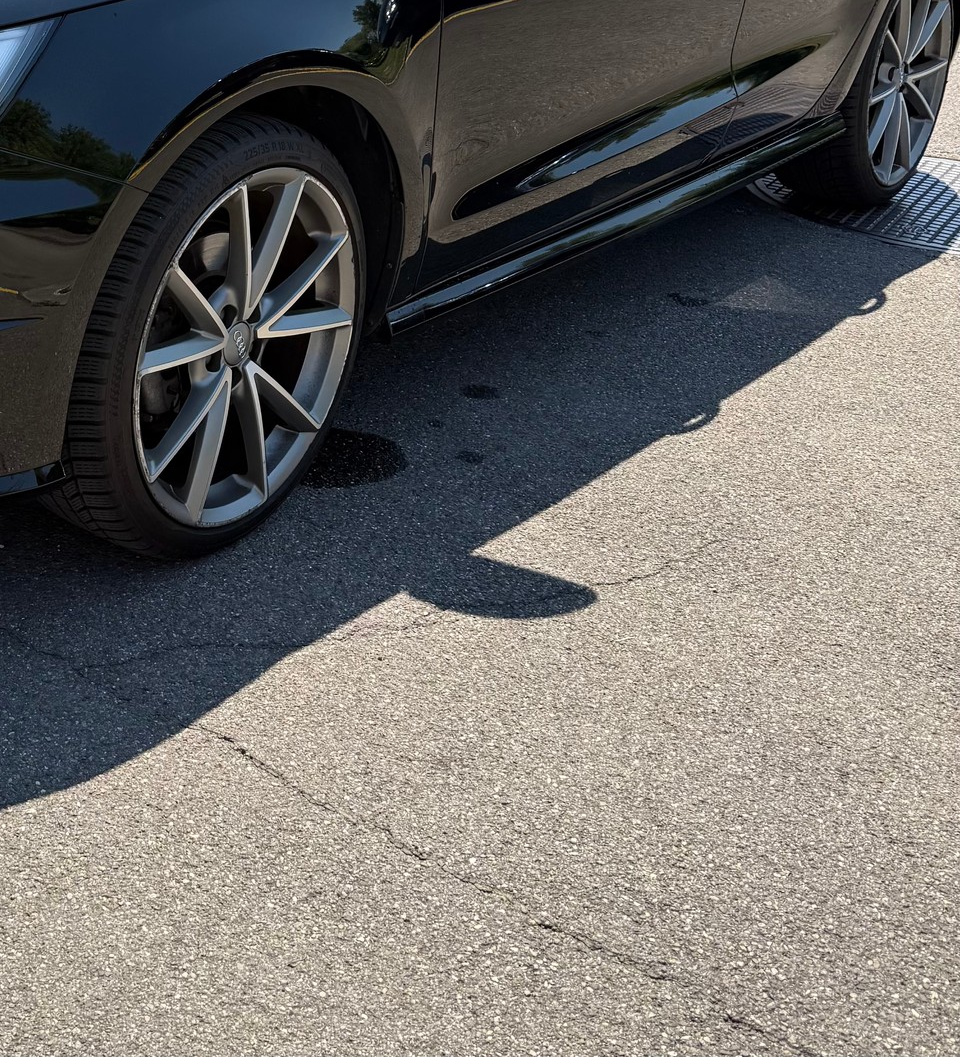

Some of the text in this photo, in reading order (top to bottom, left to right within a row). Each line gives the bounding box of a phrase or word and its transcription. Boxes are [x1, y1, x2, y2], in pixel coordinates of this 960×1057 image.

[243, 142, 271, 161] 225/35
[271, 141, 278, 151] R
[278, 141, 286, 151] 18
